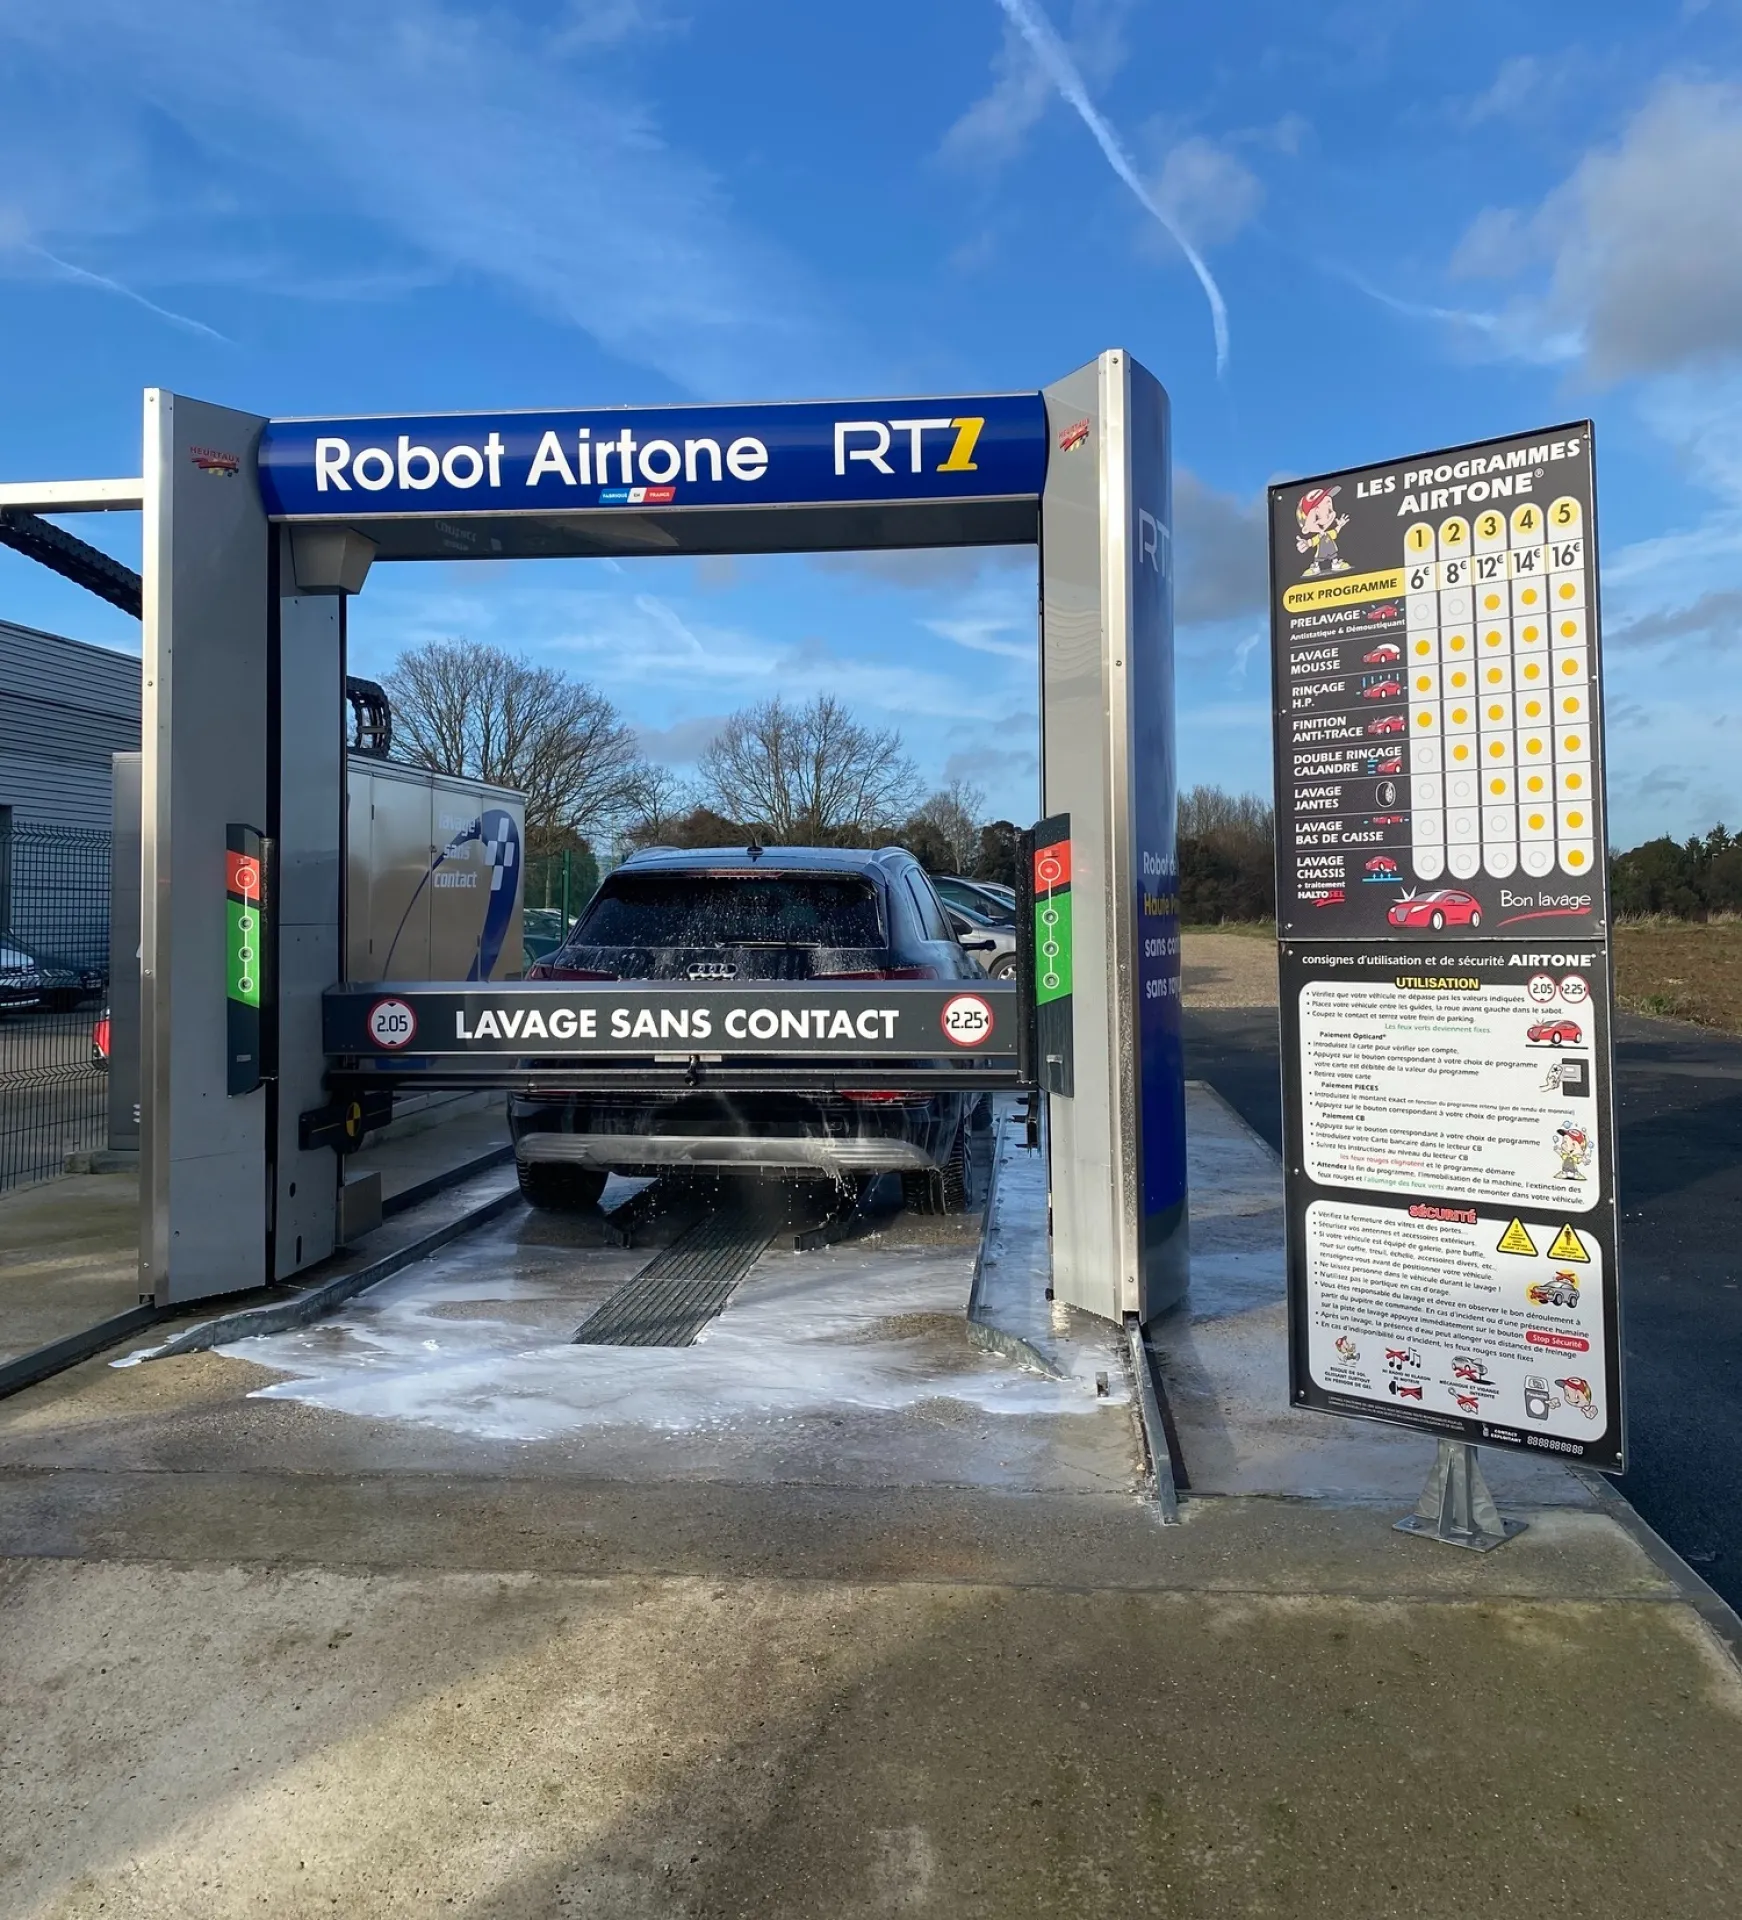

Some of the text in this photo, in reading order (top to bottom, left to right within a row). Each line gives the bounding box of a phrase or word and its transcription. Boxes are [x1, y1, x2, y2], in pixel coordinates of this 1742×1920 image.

[315, 416, 985, 491] Robot Airtone RT1
[1357, 438, 1581, 499] LES PROGRAMMES
[1415, 503, 1571, 548] 1 2 3 4 5
[1288, 541, 1581, 604] PRIX PROGRAMME 6€ 8€ 12€ 14€ 16€
[1290, 610, 1361, 629] PRELAVAGE
[1290, 627, 1336, 641] Antistatique
[1346, 618, 1406, 633] Démoustiquant
[1290, 647, 1339, 662] LAVAGE
[1290, 660, 1341, 675] MOUSSE
[1292, 682, 1345, 697] RINÇAGE
[1292, 698, 1315, 709] H.P.
[1293, 716, 1347, 731] FINITION
[1292, 727, 1364, 743] ANTI-TRACE
[1294, 746, 1402, 765] DOUBLE RINÇAGE
[1294, 762, 1359, 777] CALANDRE
[1294, 786, 1342, 799] LAVAGE
[1294, 799, 1339, 811] JANTES
[438, 809, 477, 837] lavage
[1295, 821, 1343, 833] LAVAGE
[1295, 831, 1384, 845] BAS DE CAISSE
[443, 843, 471, 860] sans
[1296, 856, 1344, 867] LAVAGE
[433, 870, 478, 888] contact
[1296, 868, 1346, 879] CHASSIS
[1304, 881, 1346, 889] traitement
[1501, 889, 1592, 910] Bon lavage
[1144, 938, 1167, 958] sans
[1302, 955, 1354, 967] consignes
[1357, 954, 1422, 966] d'utilisation
[1424, 956, 1437, 966] et
[1439, 955, 1455, 966] de
[1458, 955, 1505, 967] sécurité
[1146, 978, 1168, 999] sans
[1395, 976, 1480, 989] UTILISATION
[1532, 984, 1583, 995] 2.05 2.25
[1336, 992, 1349, 1000] que
[1368, 991, 1396, 999] véhicule
[1407, 992, 1435, 1002] dépasse
[1461, 993, 1488, 1001] valeurs
[1489, 994, 1525, 1004] indiquées
[1311, 1009, 1335, 1019] Coupez
[1344, 1010, 1368, 1018] contact
[1398, 1012, 1417, 1020] votre
[1435, 1013, 1445, 1021] de
[377, 1008, 984, 1040] 2.05 LAVAGE SANS CONTACT 2.25
[1321, 1111, 1365, 1121] Paiement CB
[1532, 1333, 1584, 1348] Stop Sécurité
